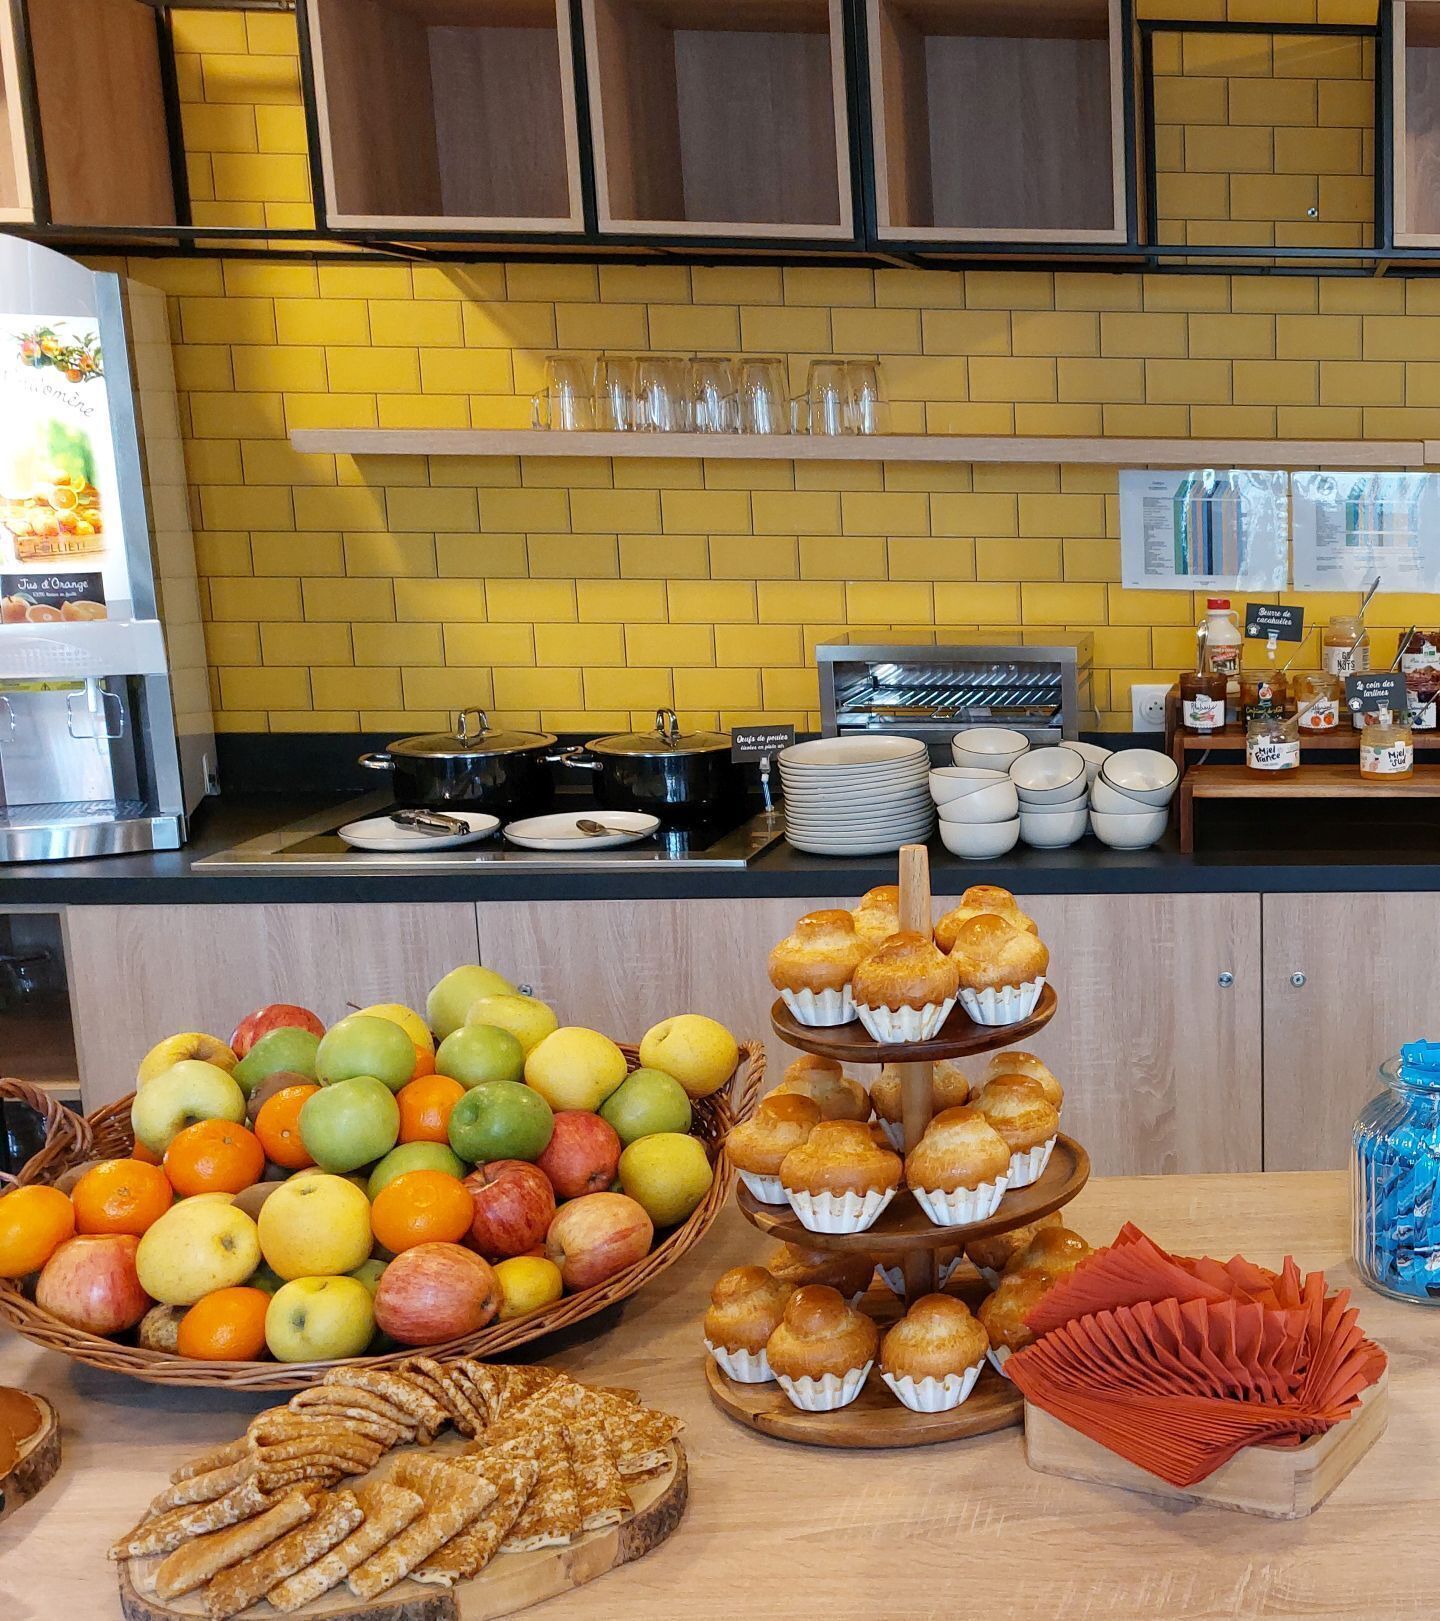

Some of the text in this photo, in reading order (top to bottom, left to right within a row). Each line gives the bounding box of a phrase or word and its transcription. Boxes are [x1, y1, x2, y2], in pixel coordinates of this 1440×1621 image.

[18, 577, 89, 592] Jus d'Orange
[1258, 607, 1292, 618] Beurre de
[1356, 680, 1395, 691] Le coin des
[1363, 688, 1390, 697] tartines
[757, 734, 766, 742] de
[766, 733, 789, 744] poules
[1258, 745, 1276, 755] Miel
[1387, 748, 1405, 758] Miel
[1254, 752, 1281, 763] France
